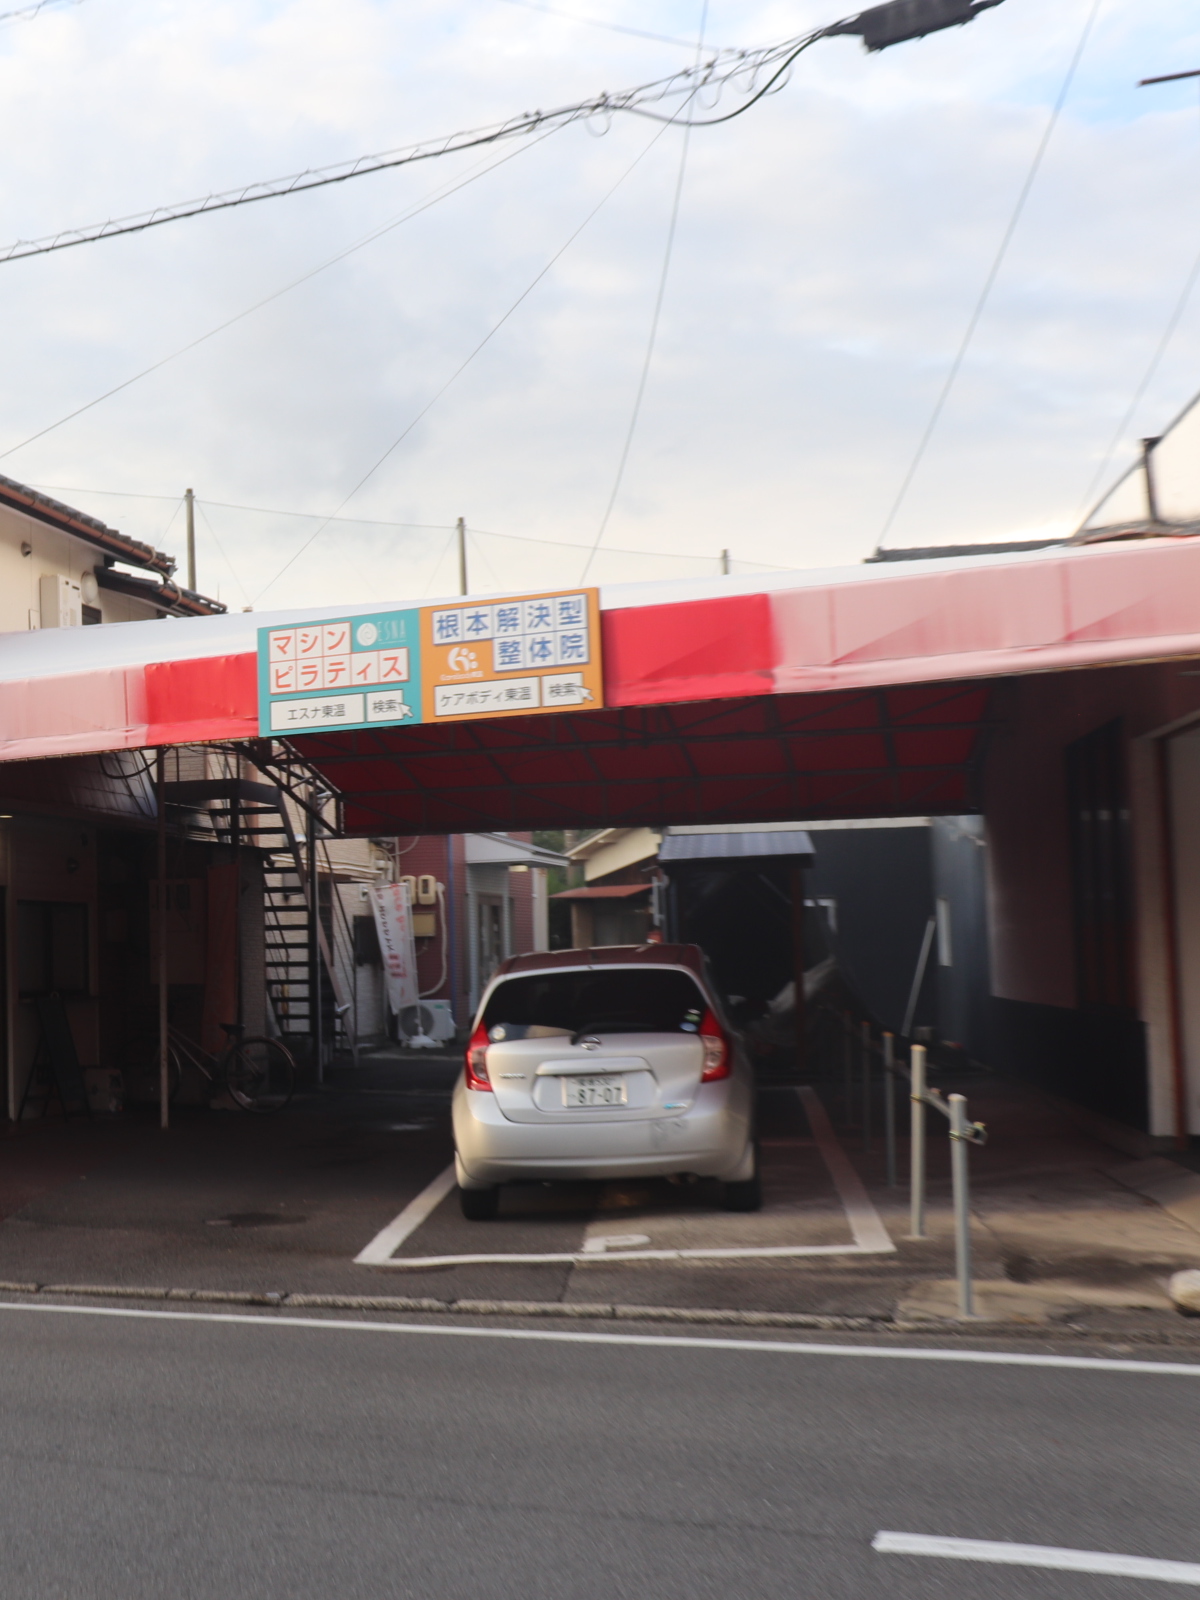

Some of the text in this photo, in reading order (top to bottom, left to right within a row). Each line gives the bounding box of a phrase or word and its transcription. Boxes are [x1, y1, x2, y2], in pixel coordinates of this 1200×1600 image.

[436, 600, 584, 640] 根本解決型
[272, 630, 346, 655] マシン
[497, 632, 585, 666] 整体院
[274, 656, 404, 689] ピラティス
[440, 686, 532, 708] ケアボディ東温
[548, 682, 577, 699] 検索
[288, 703, 346, 722] エスナ東温
[372, 699, 399, 714] 検索
